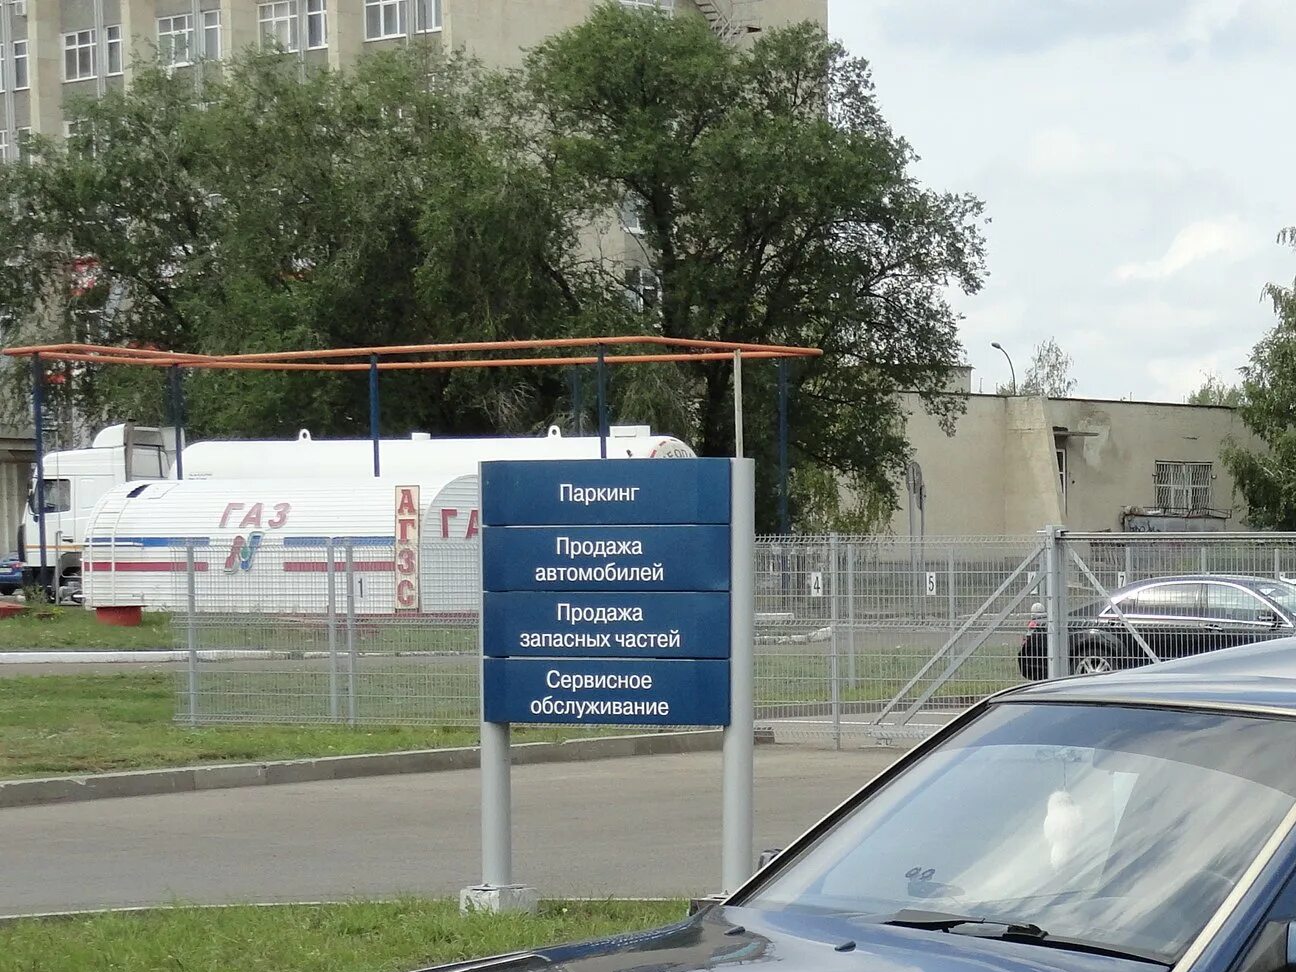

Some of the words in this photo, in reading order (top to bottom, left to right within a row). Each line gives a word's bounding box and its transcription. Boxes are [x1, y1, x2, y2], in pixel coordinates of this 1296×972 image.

[559, 483, 640, 505] Паркинг
[219, 502, 292, 529] ГАЗ
[556, 536, 643, 558] Продажа
[534, 562, 665, 582] автомобилей
[556, 603, 644, 625] Продажа
[519, 632, 611, 648] запасных
[615, 629, 681, 649] частей
[546, 669, 652, 692] Сервисное
[530, 696, 669, 718] обслуживание
